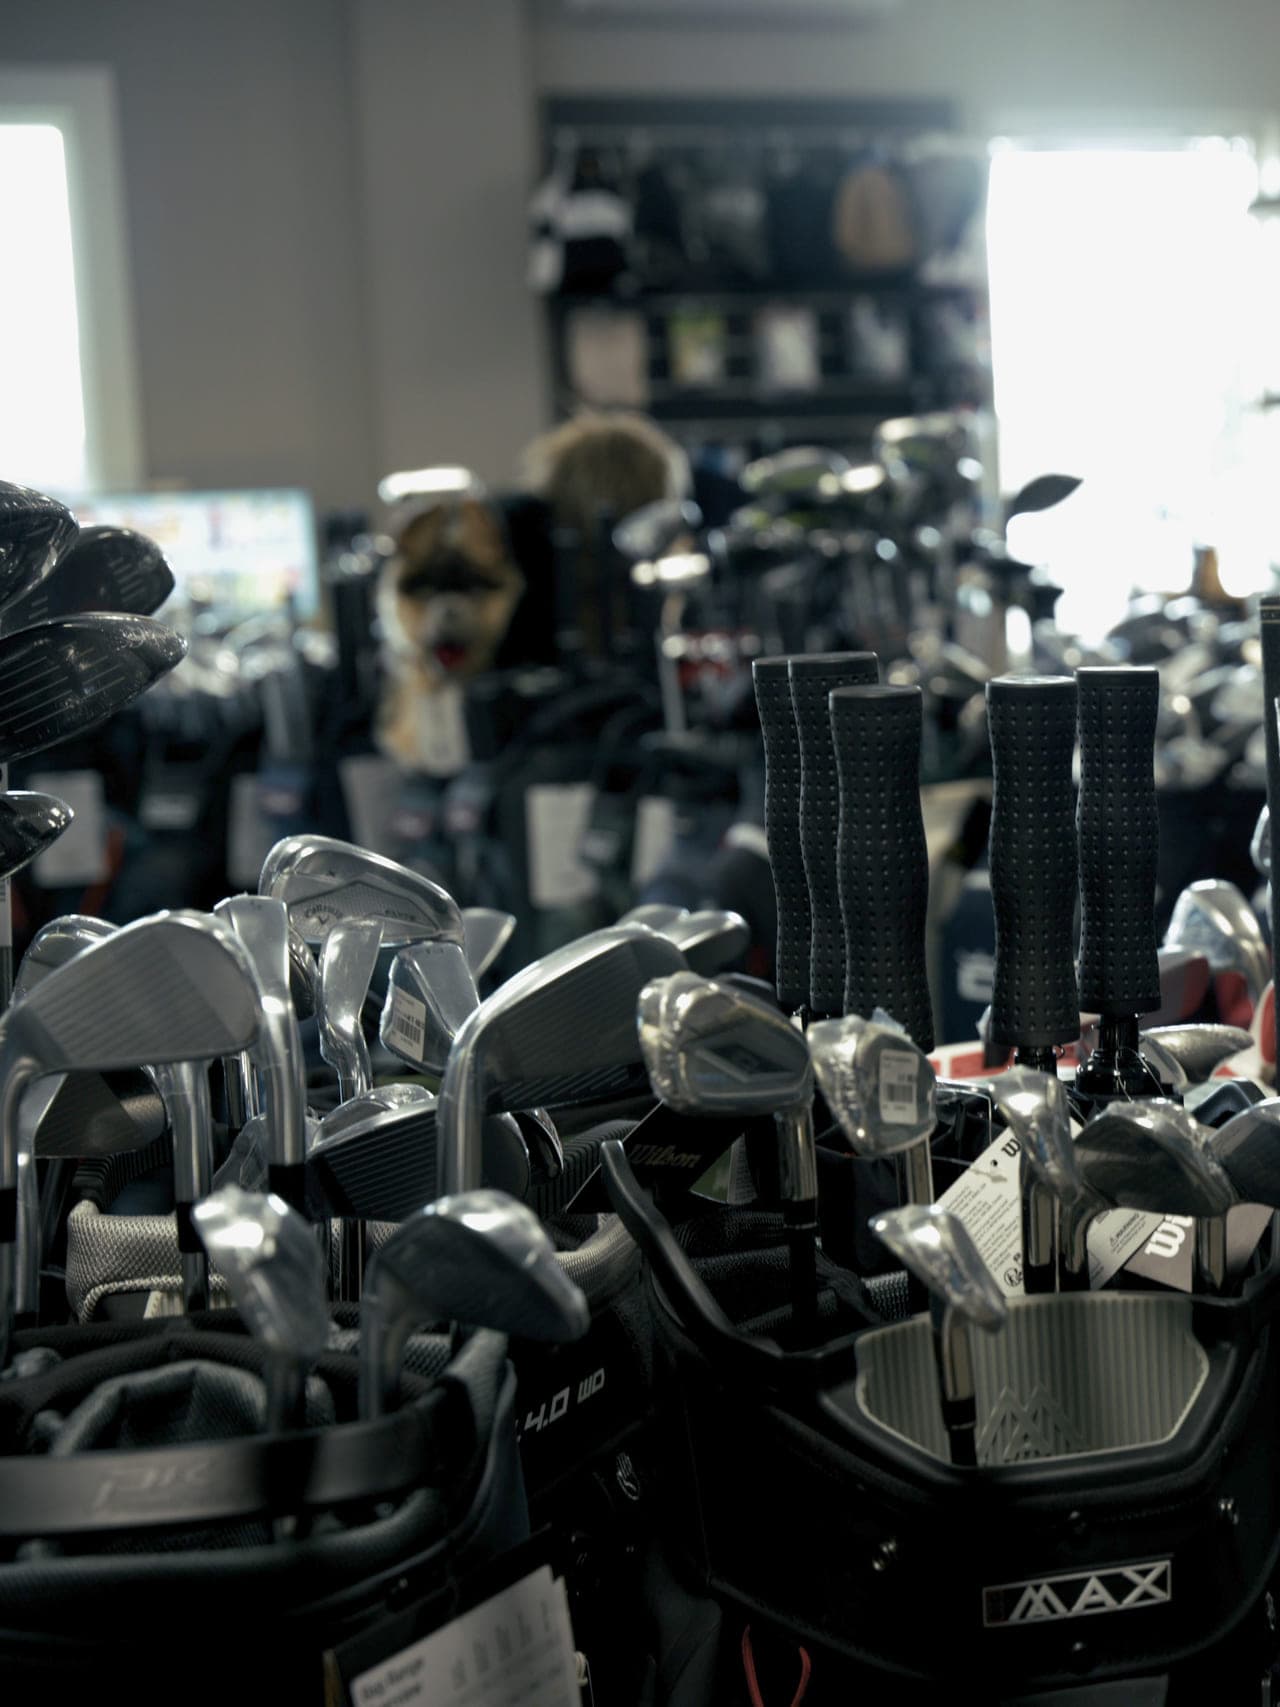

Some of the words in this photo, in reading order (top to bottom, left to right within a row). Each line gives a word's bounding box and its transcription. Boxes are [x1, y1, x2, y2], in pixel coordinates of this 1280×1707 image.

[629, 1143, 705, 1169] Wilson
[524, 1385, 571, 1432] 4.0
[1008, 1562, 1171, 1622] MAX
